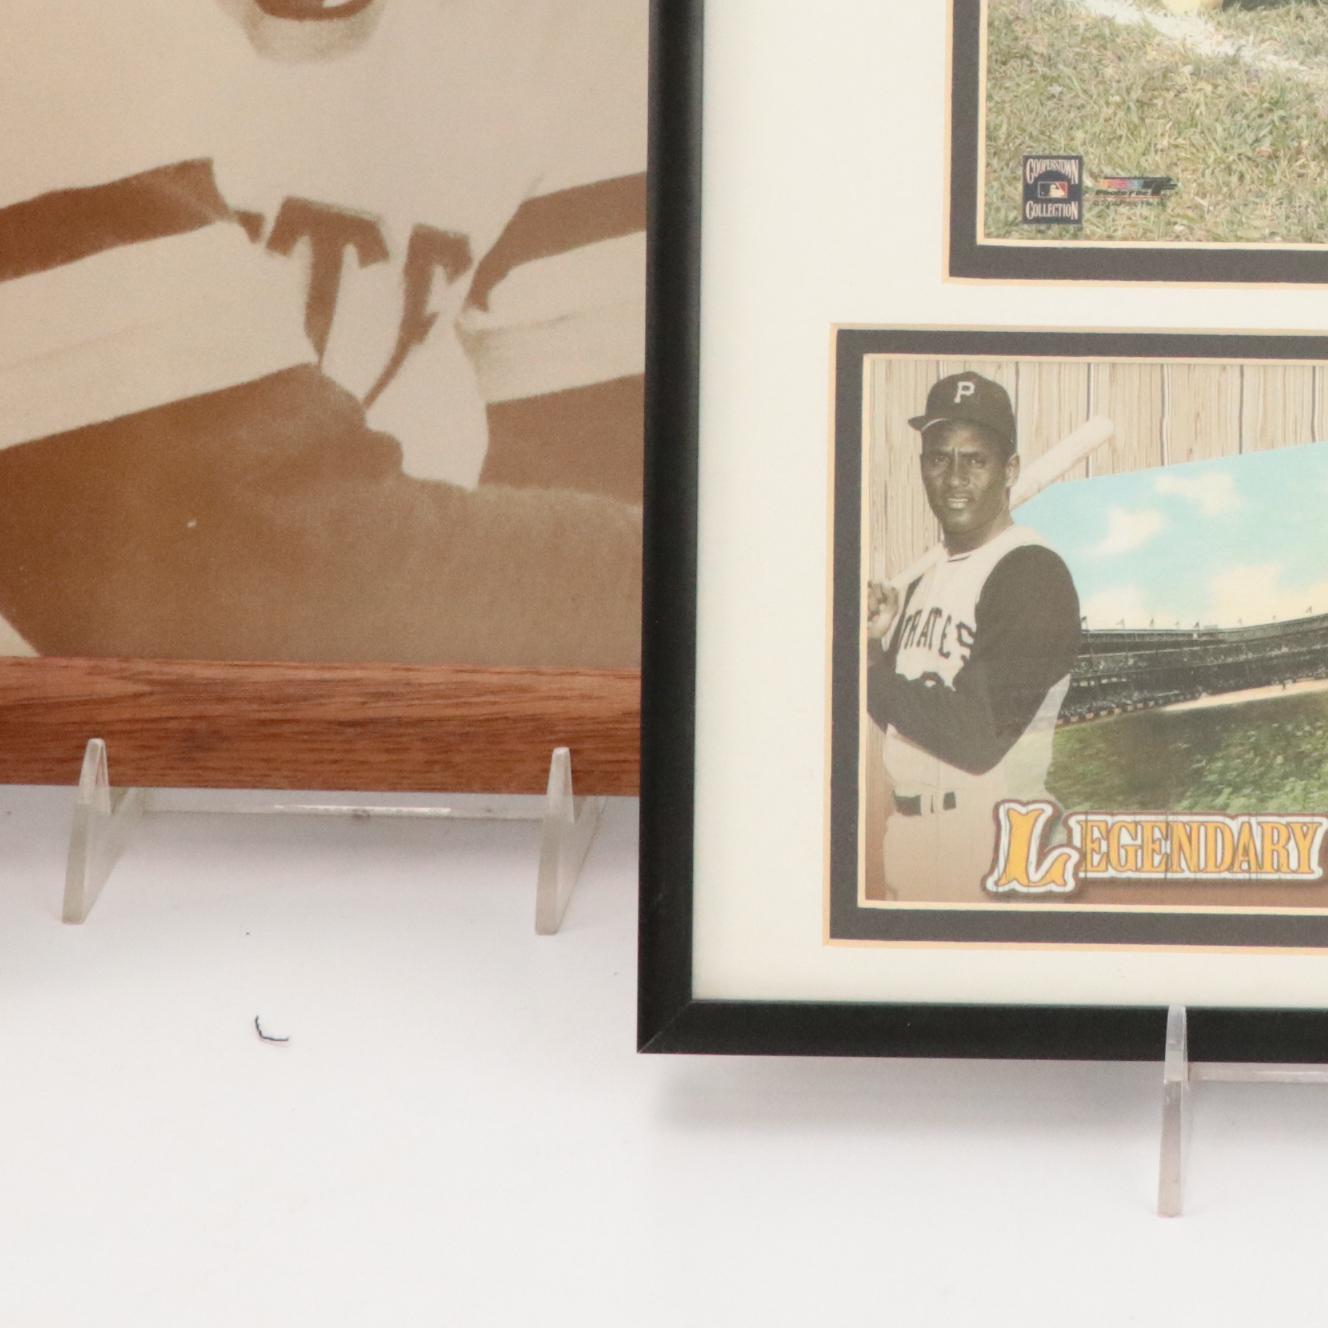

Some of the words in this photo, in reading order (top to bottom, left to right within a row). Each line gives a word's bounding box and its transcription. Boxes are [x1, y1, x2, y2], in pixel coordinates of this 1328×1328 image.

[1025, 200, 1079, 220] COLLECTION
[953, 380, 976, 403] P
[992, 804, 1327, 889] LEGENDARY
